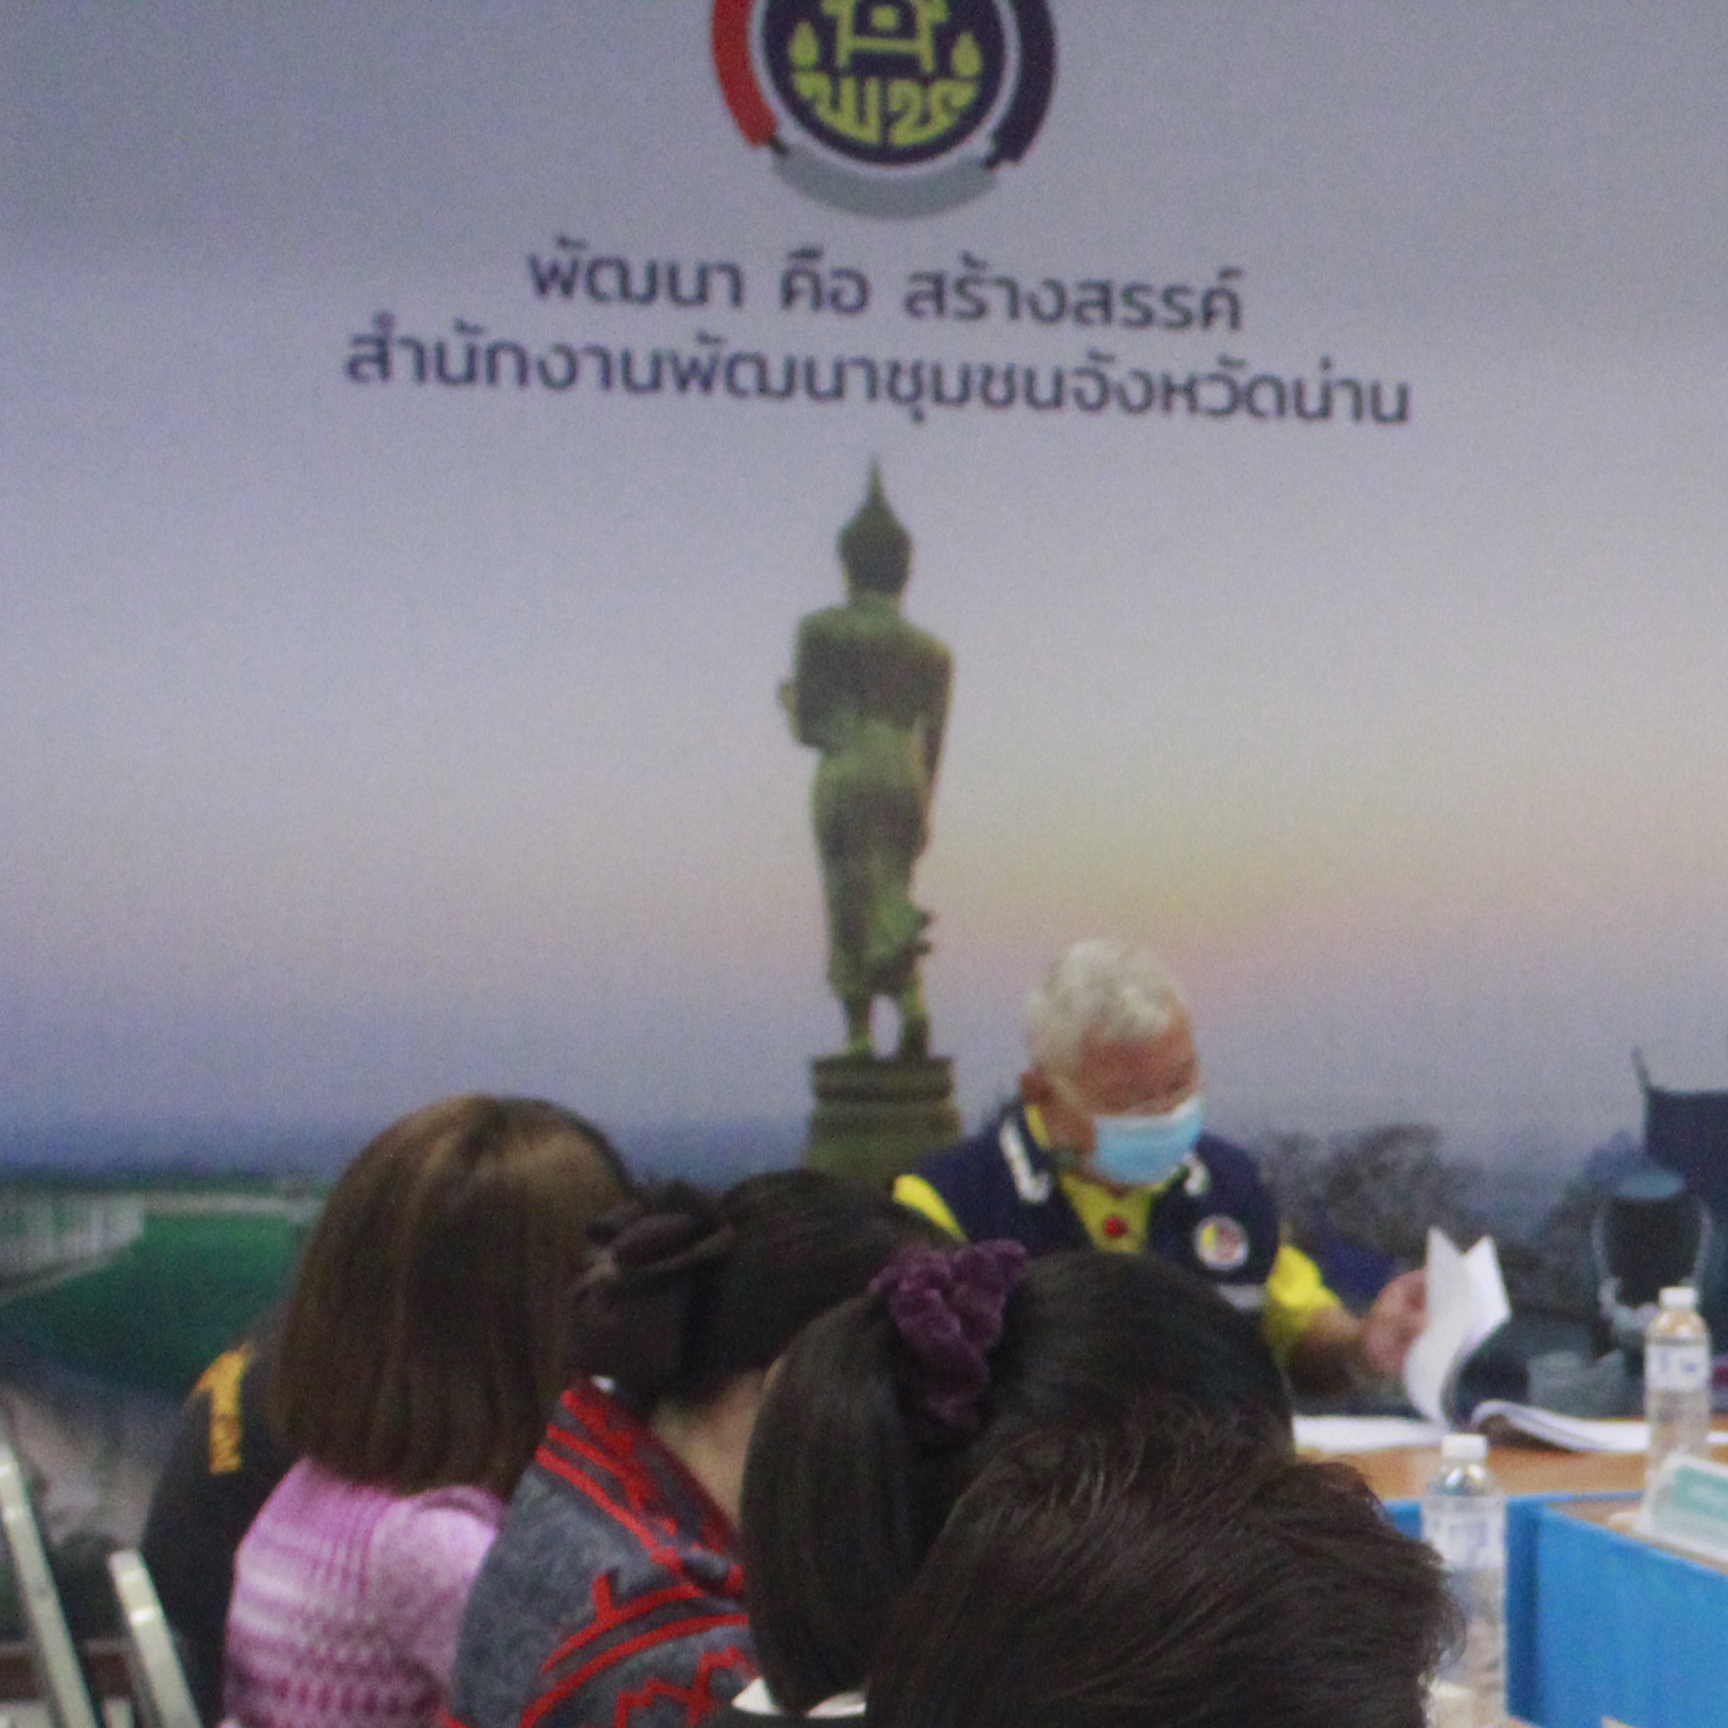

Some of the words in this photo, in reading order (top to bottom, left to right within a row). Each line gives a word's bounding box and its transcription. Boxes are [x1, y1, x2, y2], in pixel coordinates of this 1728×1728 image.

[527, 234, 744, 308] พัฒนา
[779, 245, 871, 315] คือ
[902, 250, 1243, 332] สร้างสรรค์
[345, 308, 1410, 426] สำนักงานพัฒนาชุมชนจังหวัดน่าน
